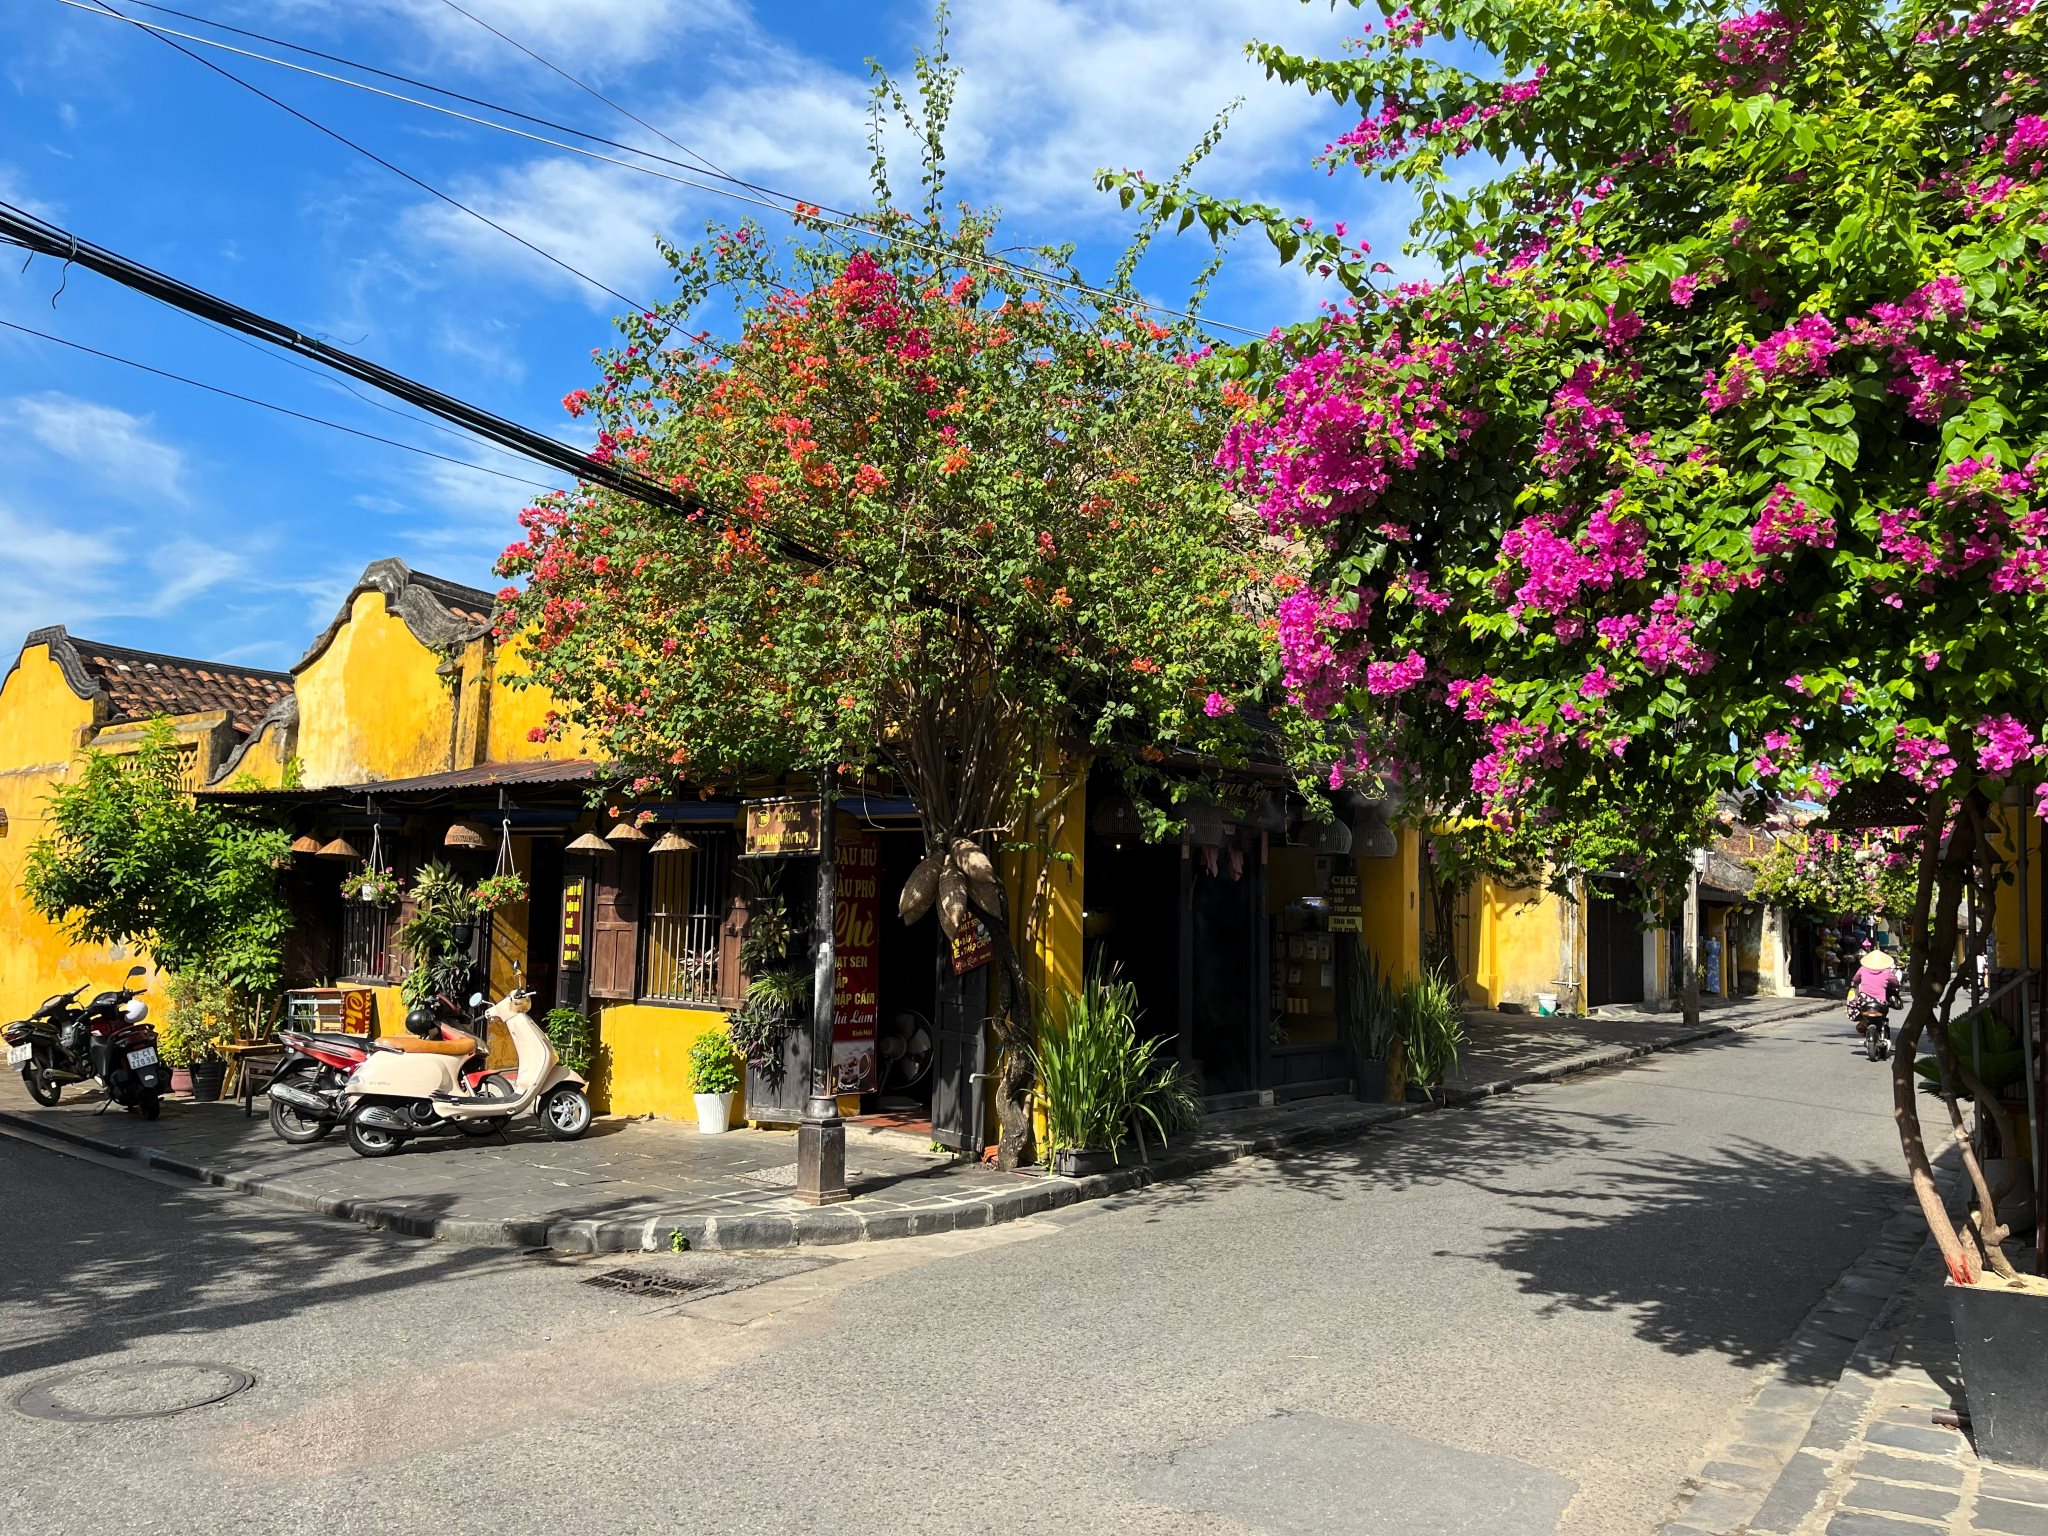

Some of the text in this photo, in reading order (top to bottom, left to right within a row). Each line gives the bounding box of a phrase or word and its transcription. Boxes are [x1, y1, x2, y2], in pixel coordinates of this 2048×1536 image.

[756, 831, 779, 846] HOÀNG
[849, 955, 868, 968] SEN
[834, 990, 852, 1008] HẬP
[834, 1010, 848, 1025] hà
